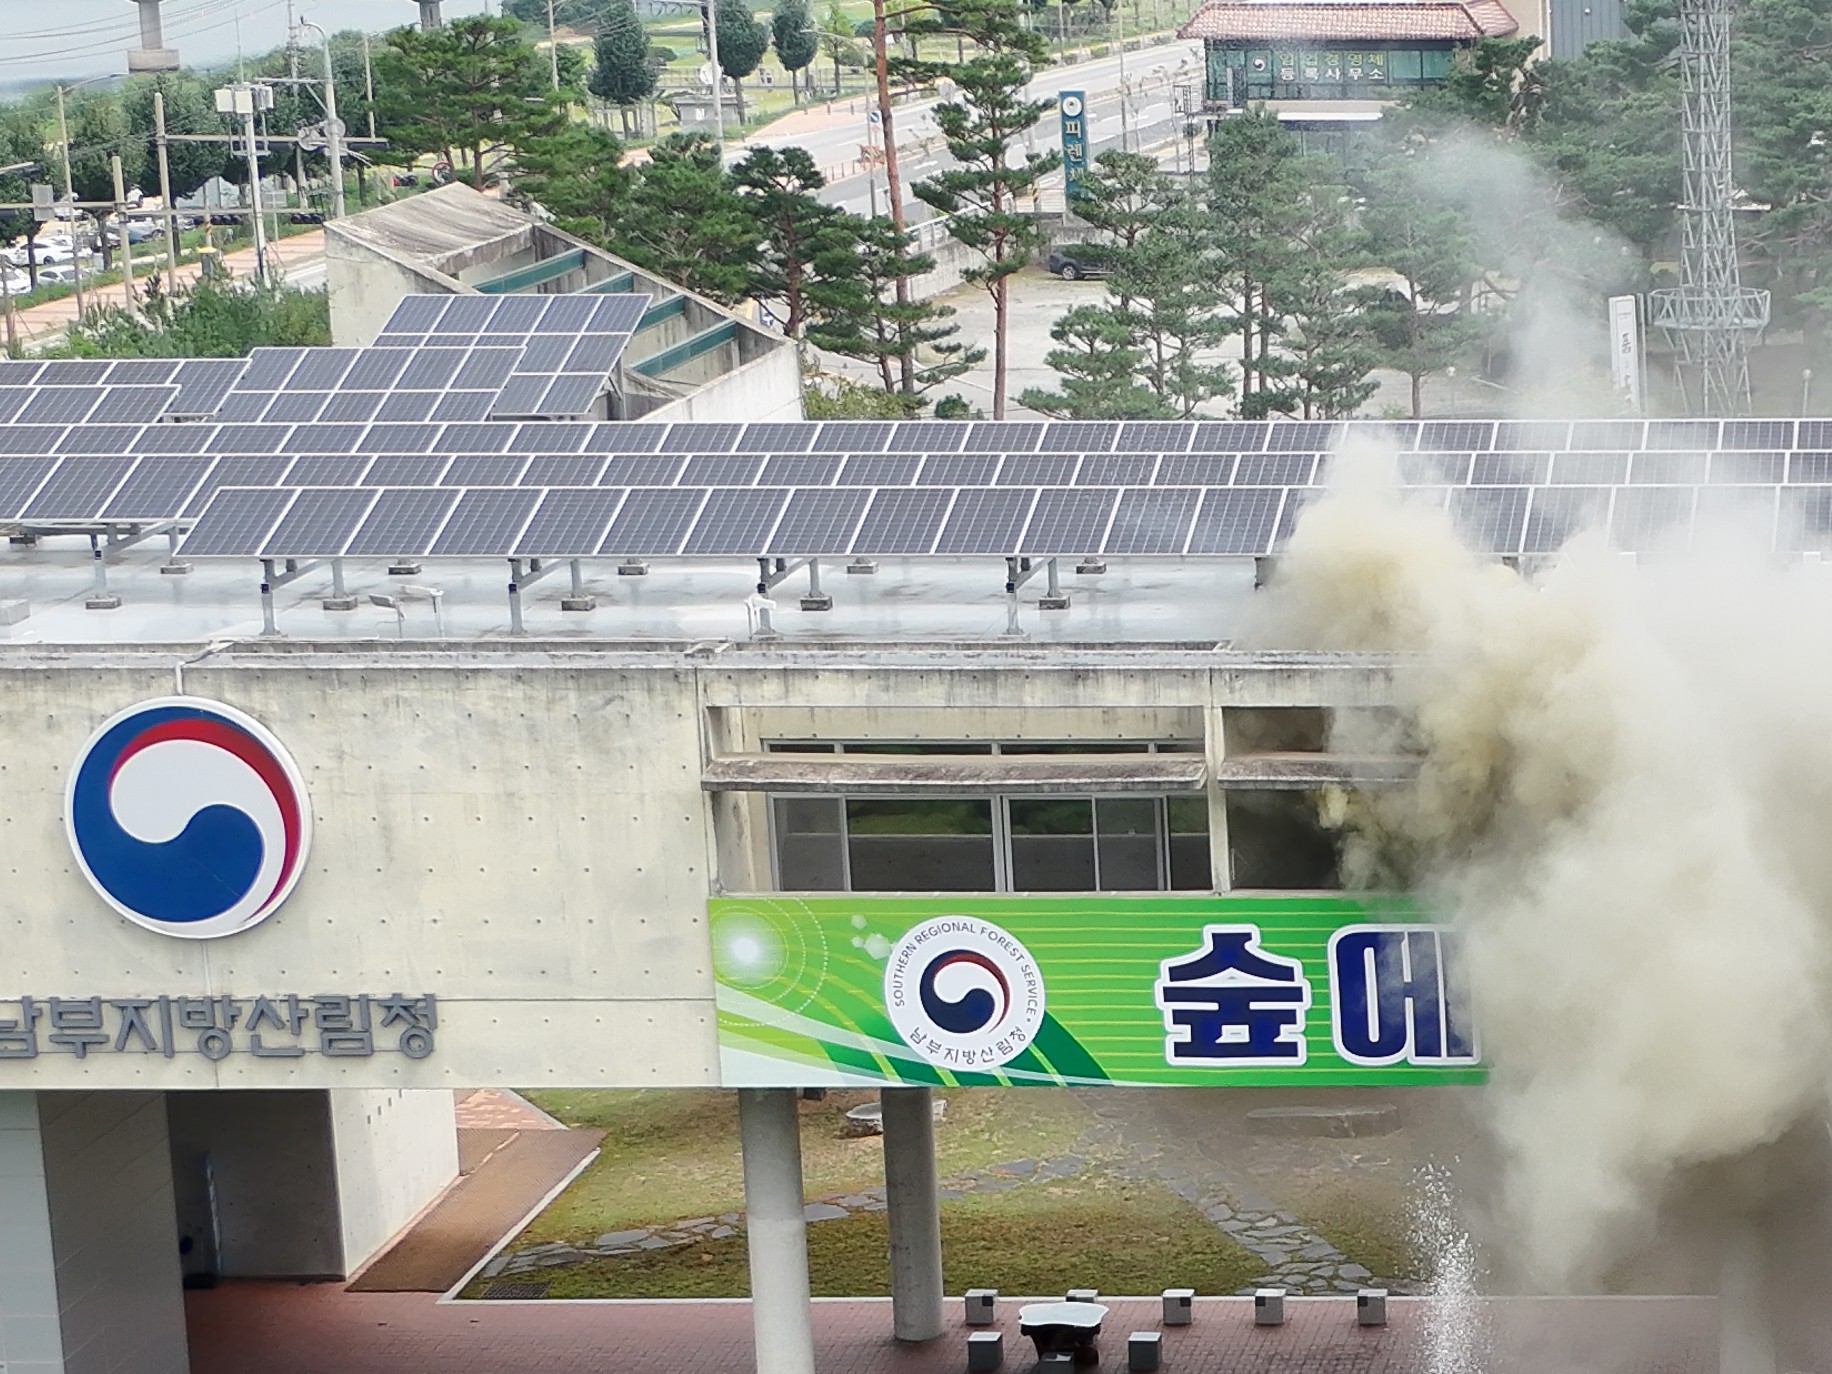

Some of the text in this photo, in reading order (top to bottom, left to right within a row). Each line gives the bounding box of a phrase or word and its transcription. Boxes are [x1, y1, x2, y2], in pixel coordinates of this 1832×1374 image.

[1280, 68, 1385, 81] 등록사무소
[892, 921, 1039, 1016] SOUTHERN REGIONAL FOREST SERVICE
[0, 993, 438, 1060] 남부지방산림청
[910, 1026, 1026, 1065] 남부지방산림청
